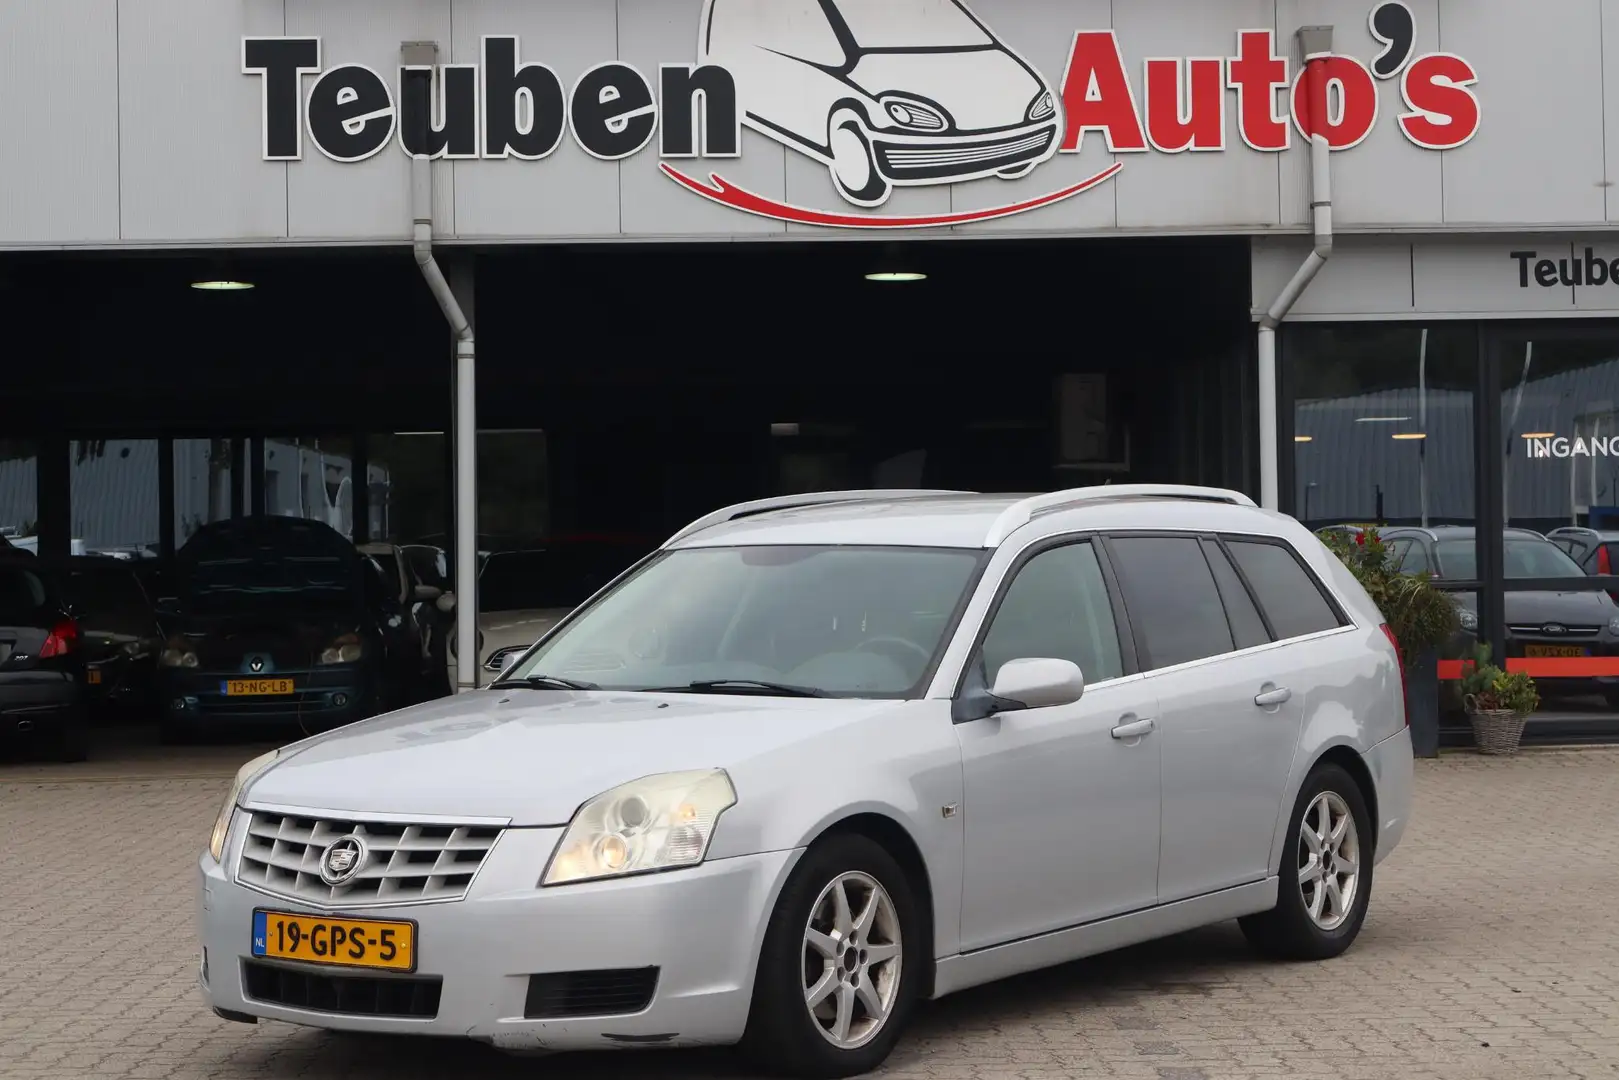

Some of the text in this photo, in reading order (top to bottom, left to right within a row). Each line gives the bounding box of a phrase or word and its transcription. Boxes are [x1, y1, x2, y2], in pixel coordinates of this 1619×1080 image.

[242, 2, 1480, 162] Teuben Auto's
[232, 681, 288, 693] 13-NG-LB
[255, 937, 265, 948] NL
[276, 920, 397, 961] 19-GPS-5
